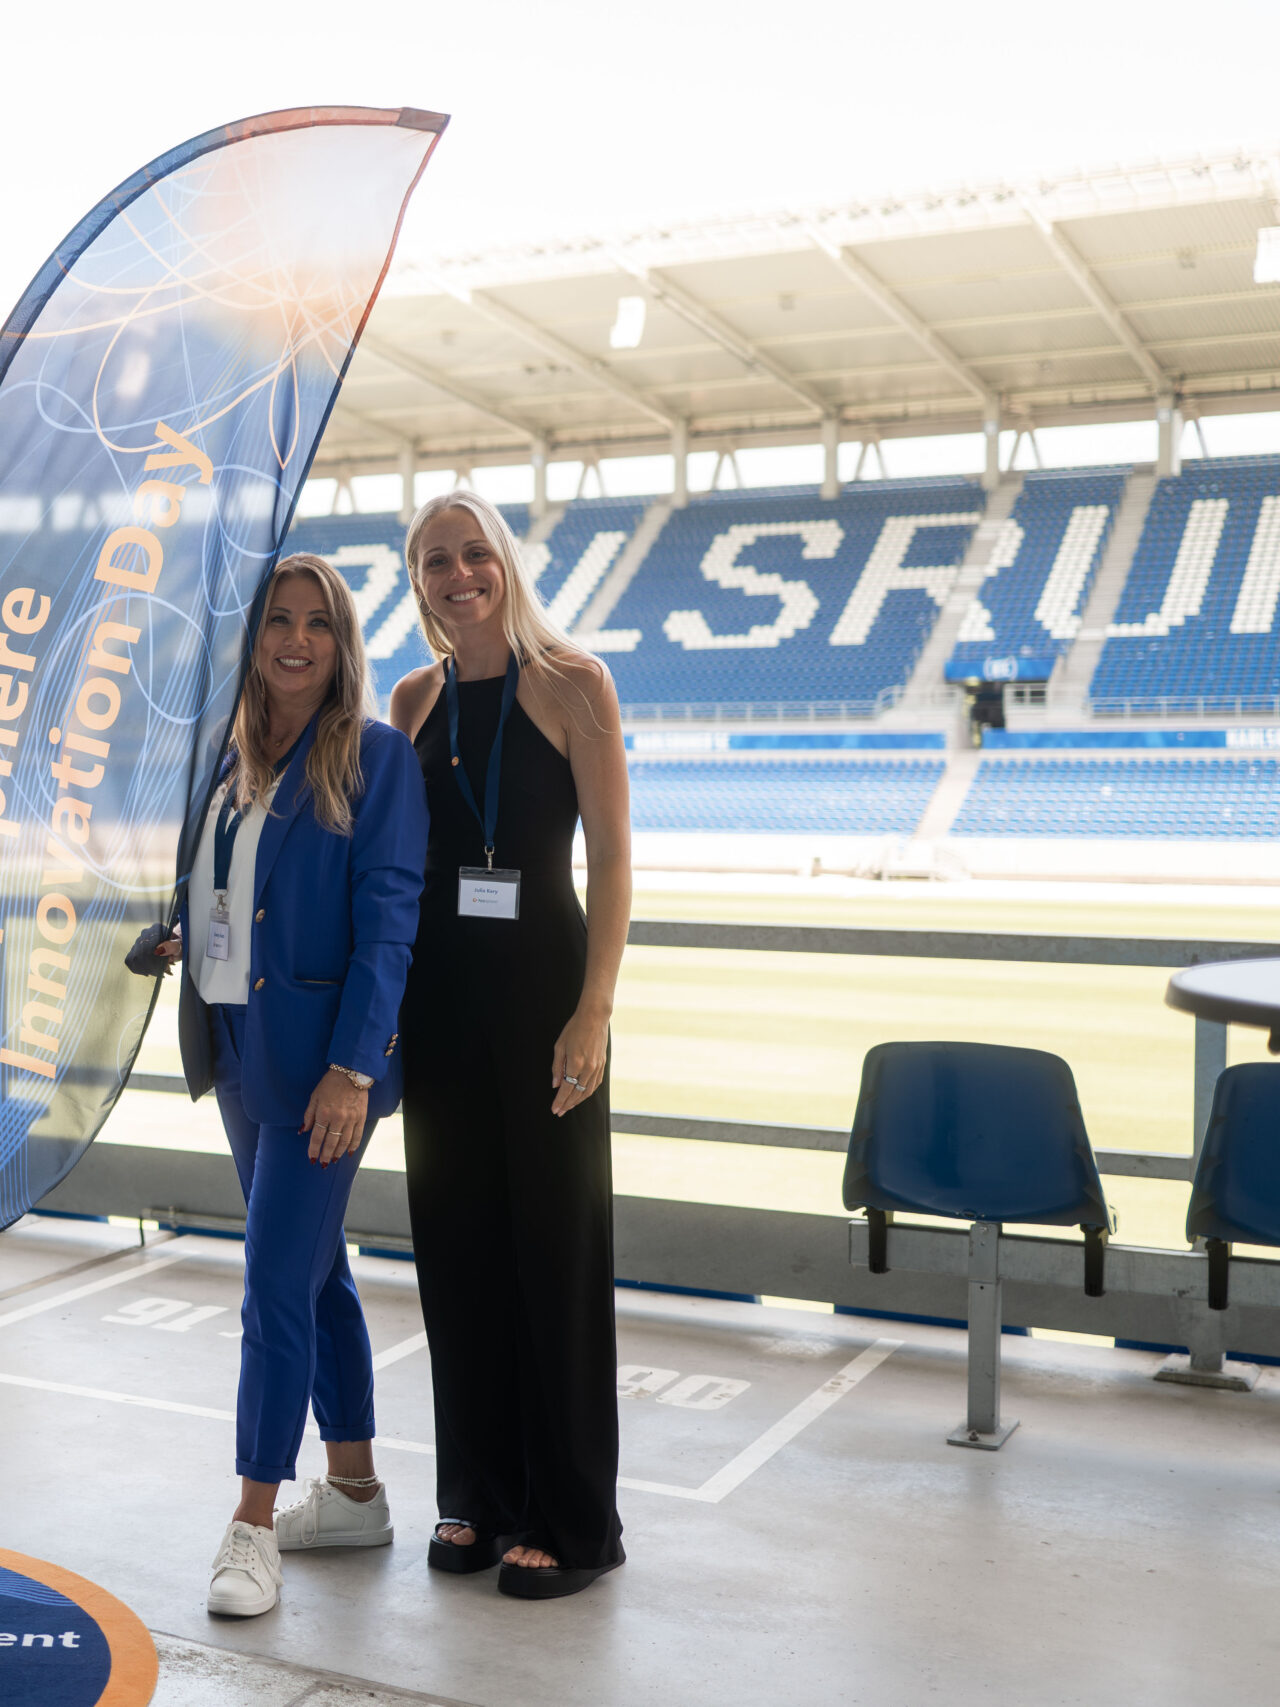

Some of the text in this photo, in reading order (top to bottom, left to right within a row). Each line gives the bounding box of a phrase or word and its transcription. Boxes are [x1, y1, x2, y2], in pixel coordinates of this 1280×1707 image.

[0, 420, 214, 1079] Innovation Day
[100, 1297, 229, 1333] 91
[617, 1364, 752, 1411] 90
